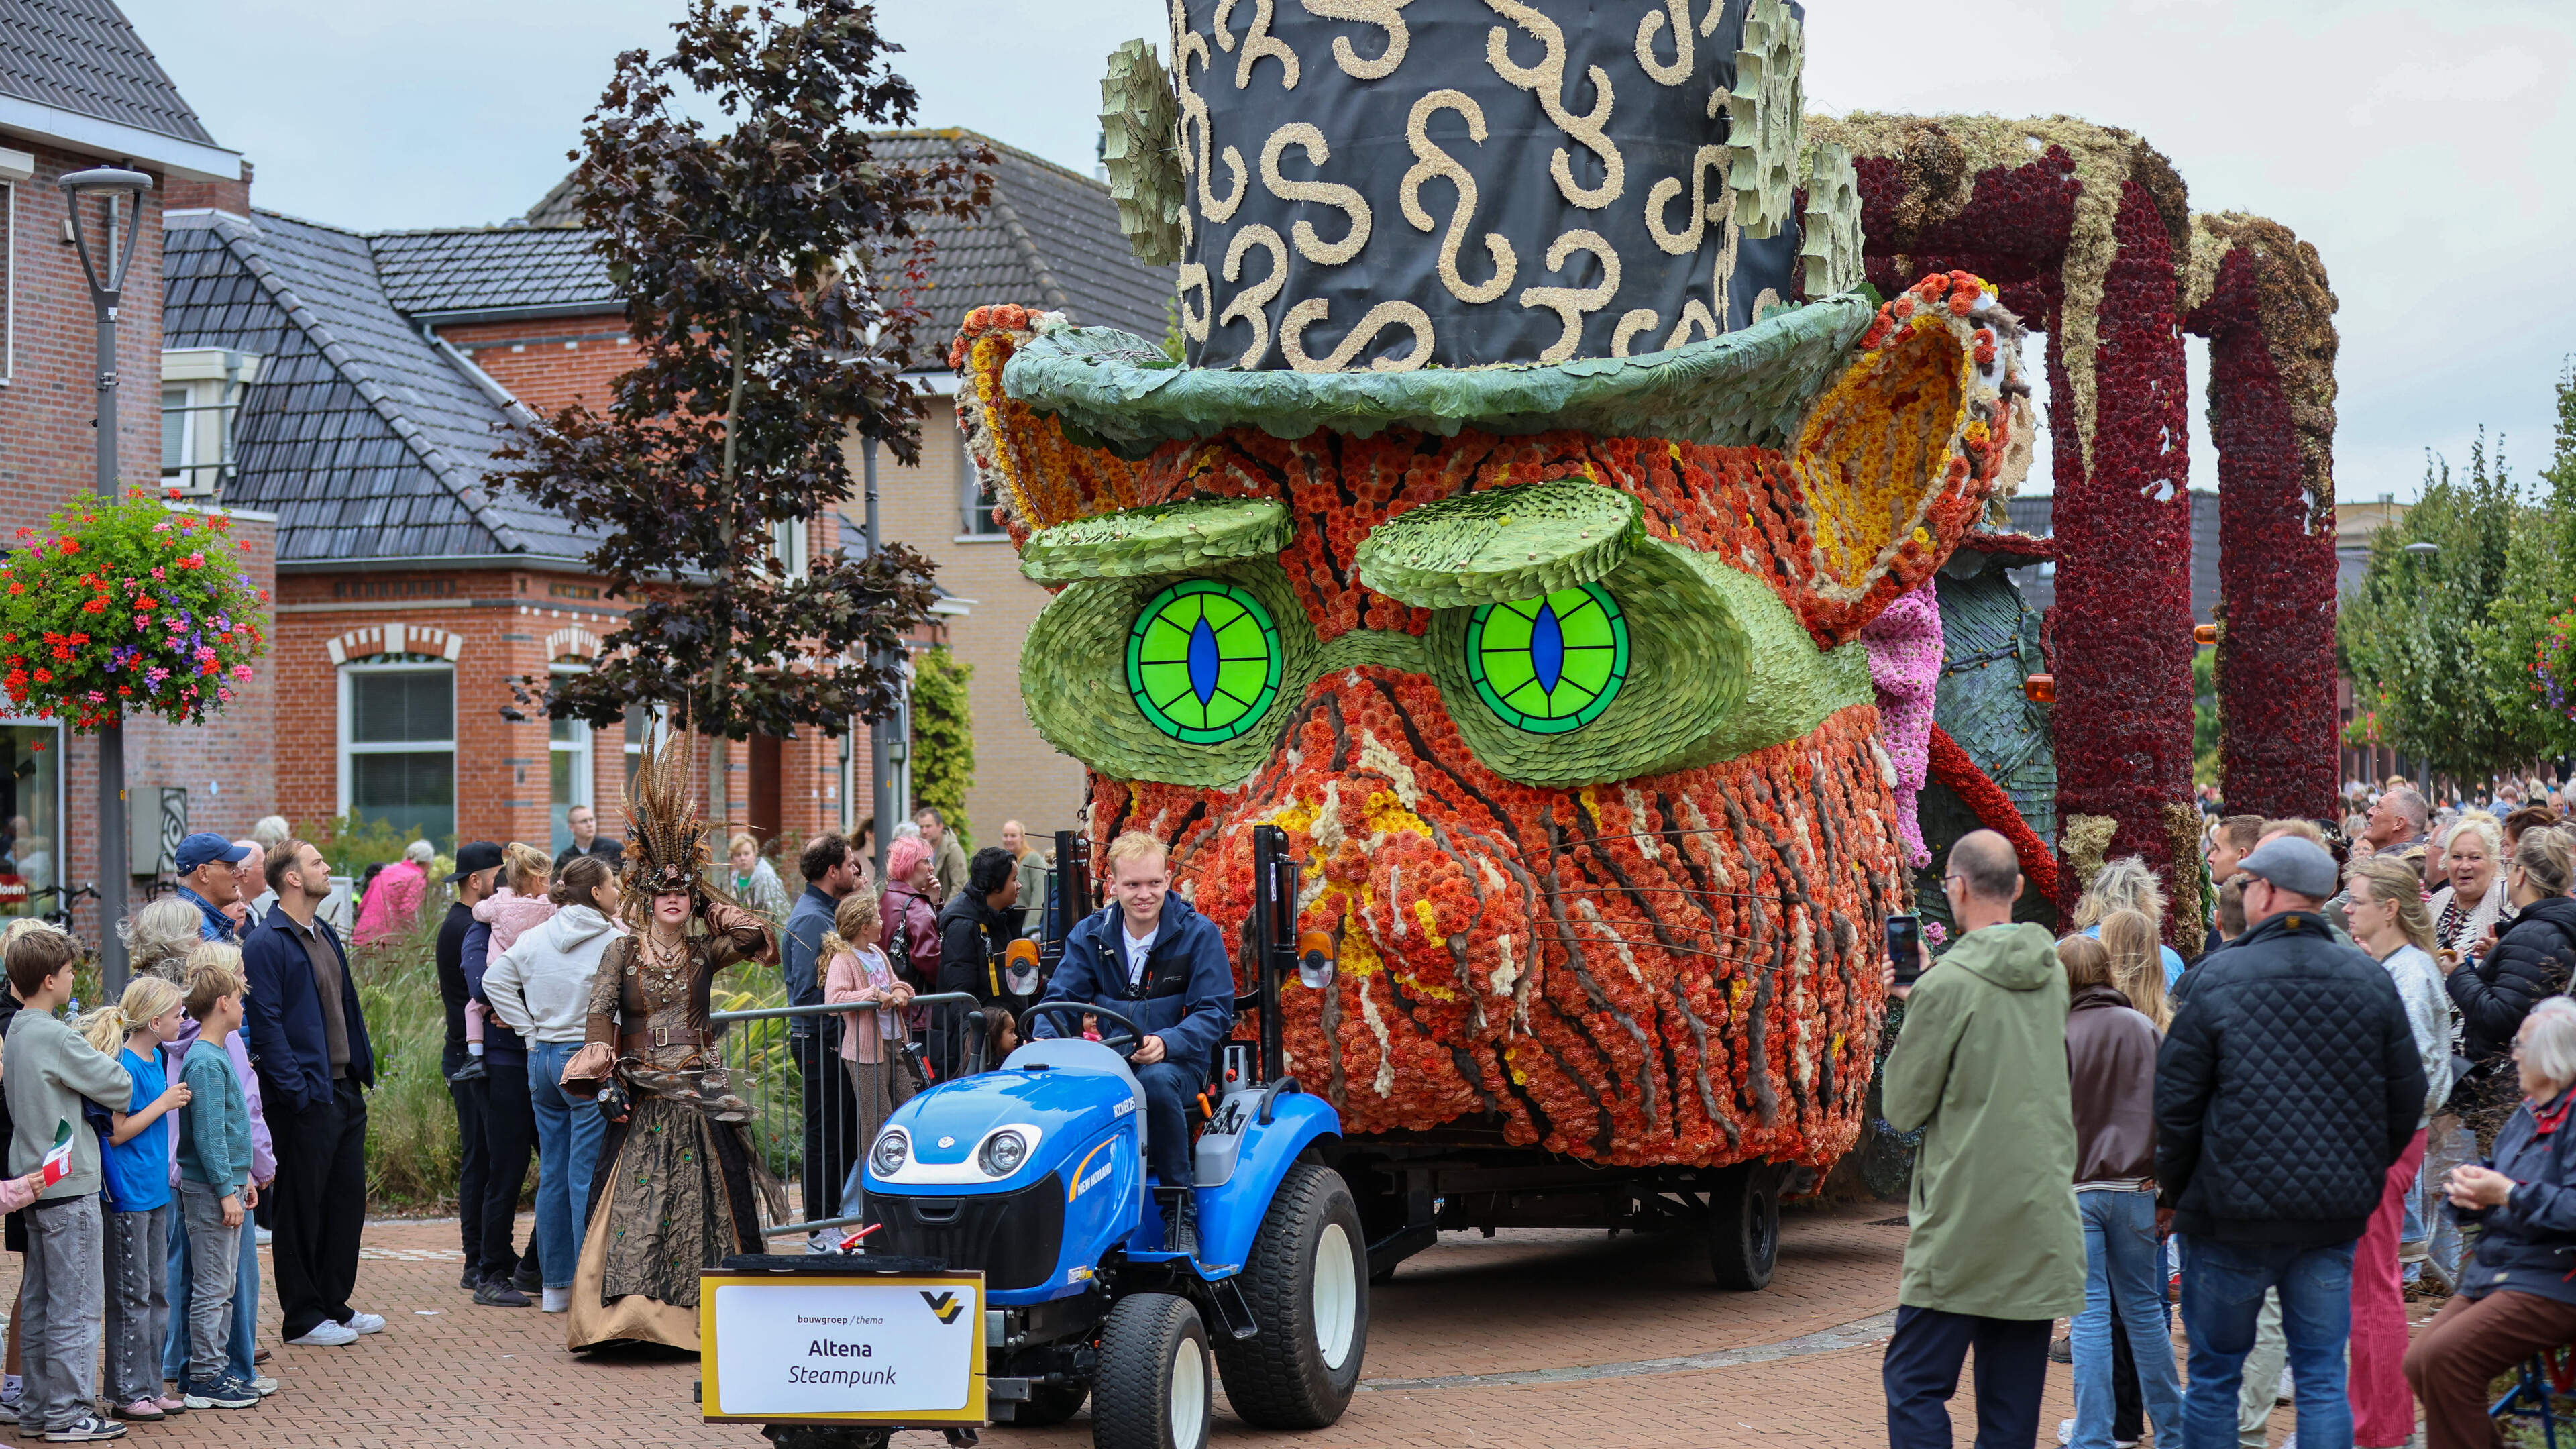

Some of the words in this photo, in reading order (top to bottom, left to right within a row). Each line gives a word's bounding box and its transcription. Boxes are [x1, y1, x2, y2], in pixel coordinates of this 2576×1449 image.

[1077, 1177, 1091, 1196] NEW
[1090, 1162, 1112, 1187] HOLLAND
[798, 1315, 848, 1326] bouwgroep
[856, 1316, 883, 1324] thema
[808, 1338, 872, 1358] Altena
[788, 1365, 896, 1389] Steampunk
